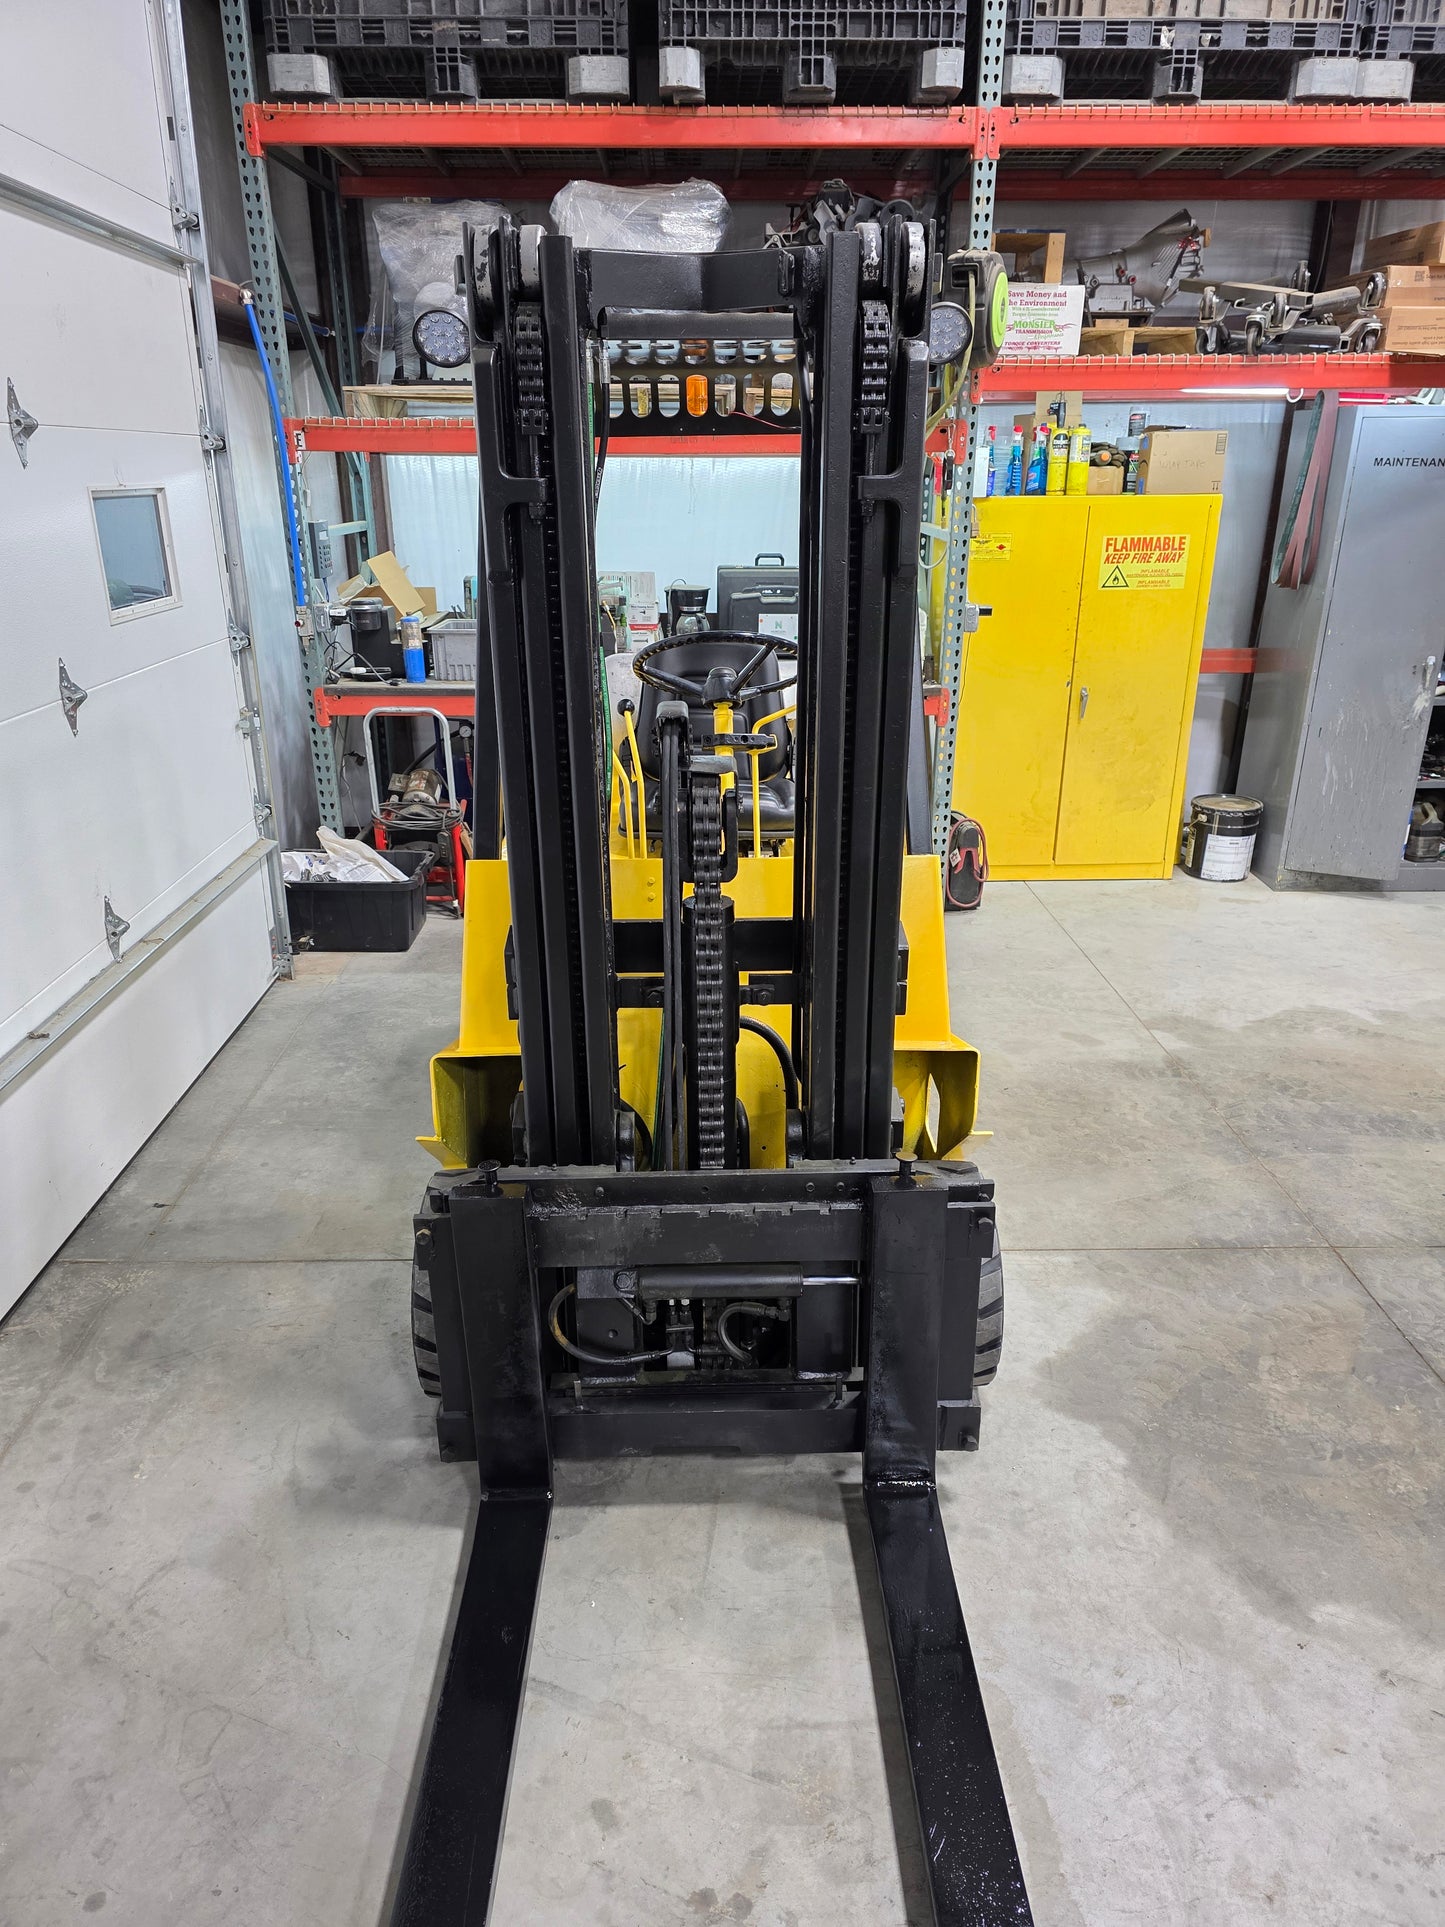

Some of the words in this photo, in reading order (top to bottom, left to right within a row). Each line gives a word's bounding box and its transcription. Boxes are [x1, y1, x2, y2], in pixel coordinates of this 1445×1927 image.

[1008, 290, 1025, 298] Save
[1026, 290, 1052, 299] Money
[1019, 299, 1067, 307] Environment
[296, 433, 303, 447] E
[1373, 457, 1445, 467] MAINTENAN
[1105, 536, 1187, 552] FLAMMABLE
[1103, 553, 1130, 564] KEEP
[1130, 552, 1155, 564] FIRE
[1154, 551, 1185, 564] AWAY
